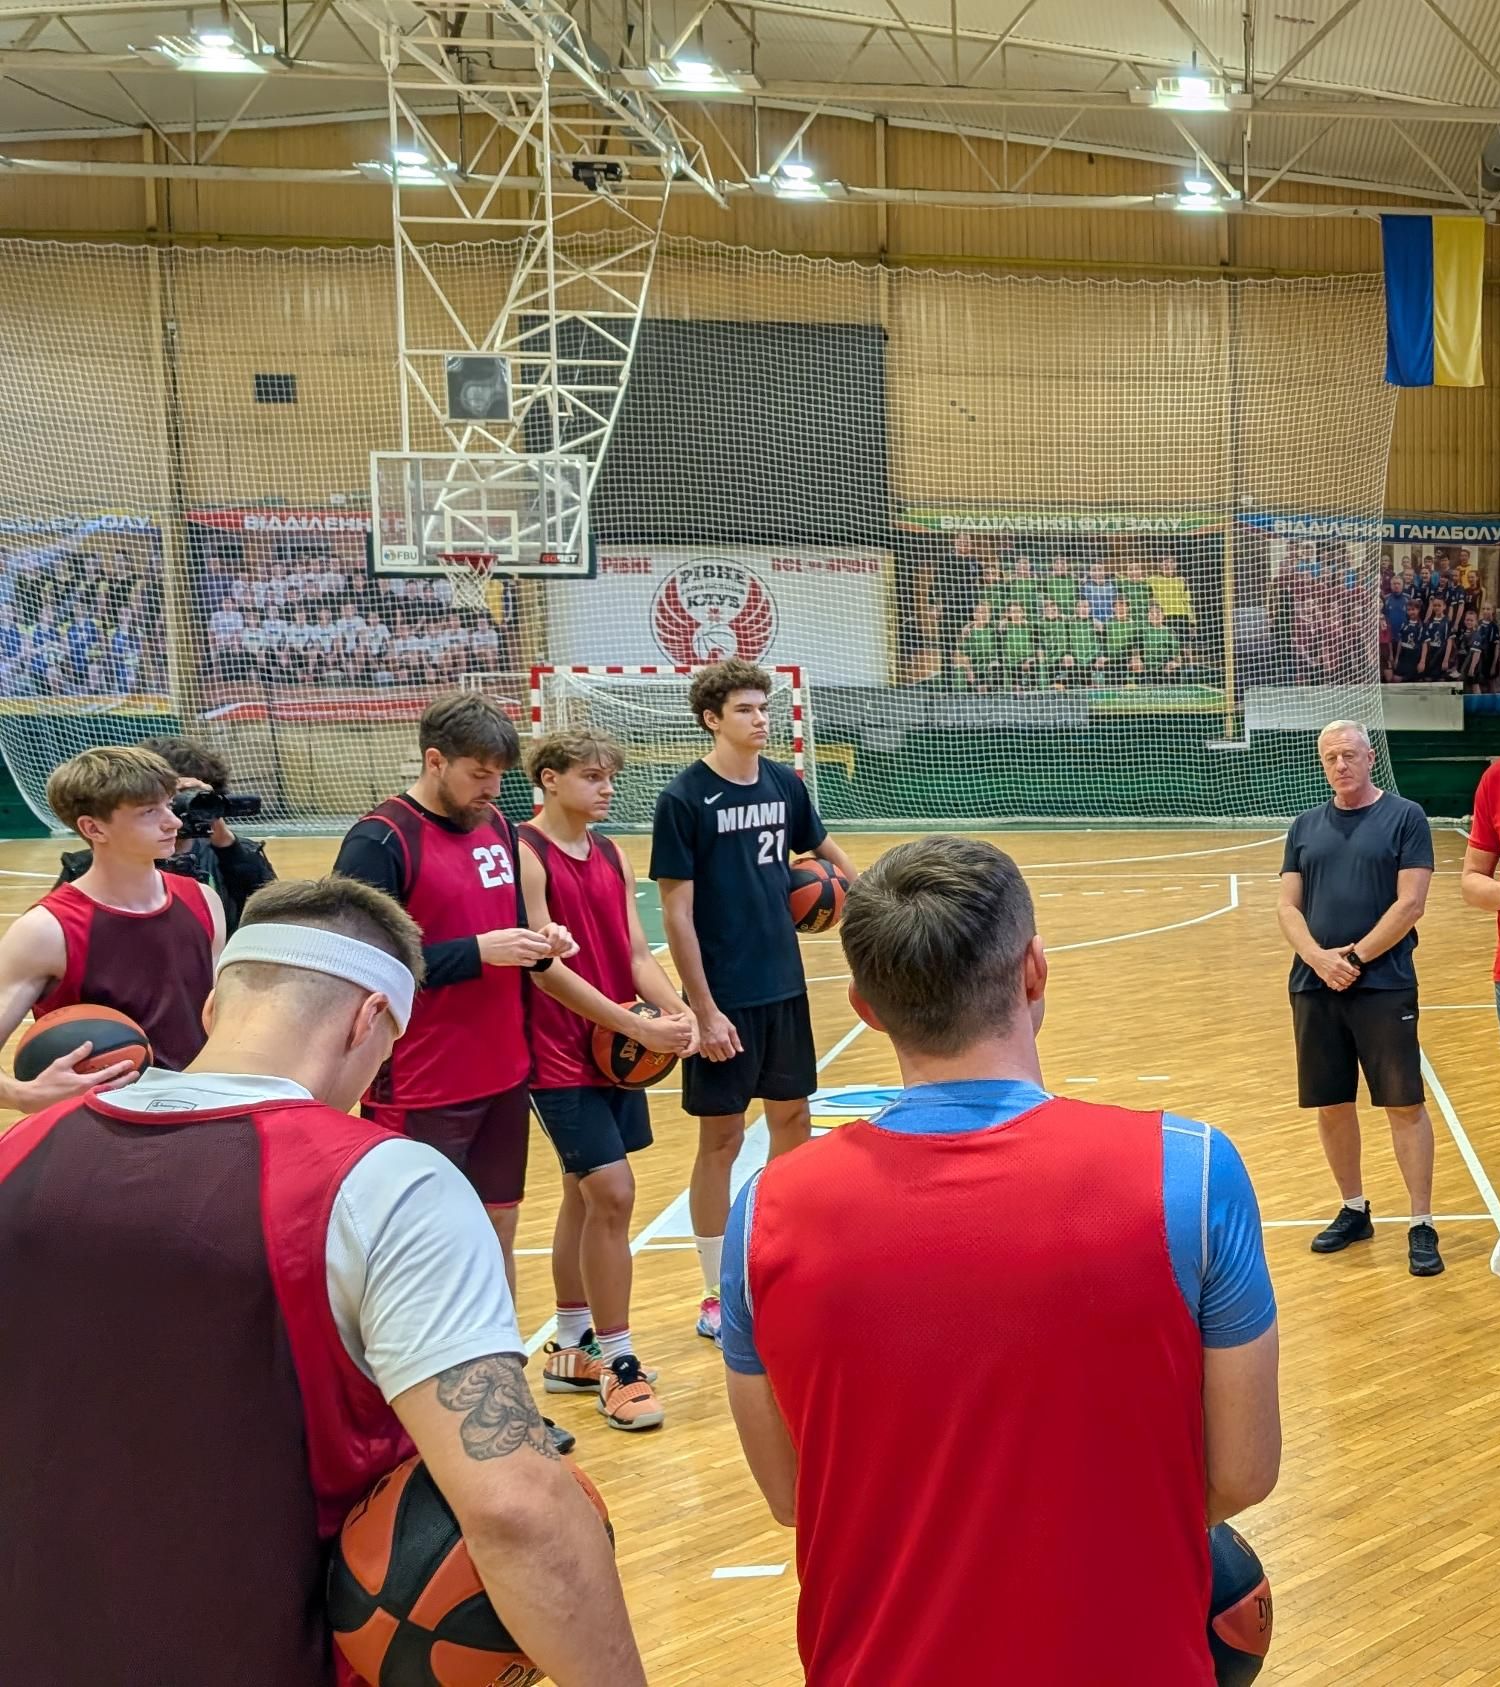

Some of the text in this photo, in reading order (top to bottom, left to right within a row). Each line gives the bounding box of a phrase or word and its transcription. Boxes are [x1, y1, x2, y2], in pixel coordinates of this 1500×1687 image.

[1274, 519, 1395, 538] ВІДДІЛЕННЯ
[397, 550, 417, 560] FBU
[717, 801, 786, 834] MIAMI
[757, 829, 786, 865] 21
[472, 844, 514, 889] 23
